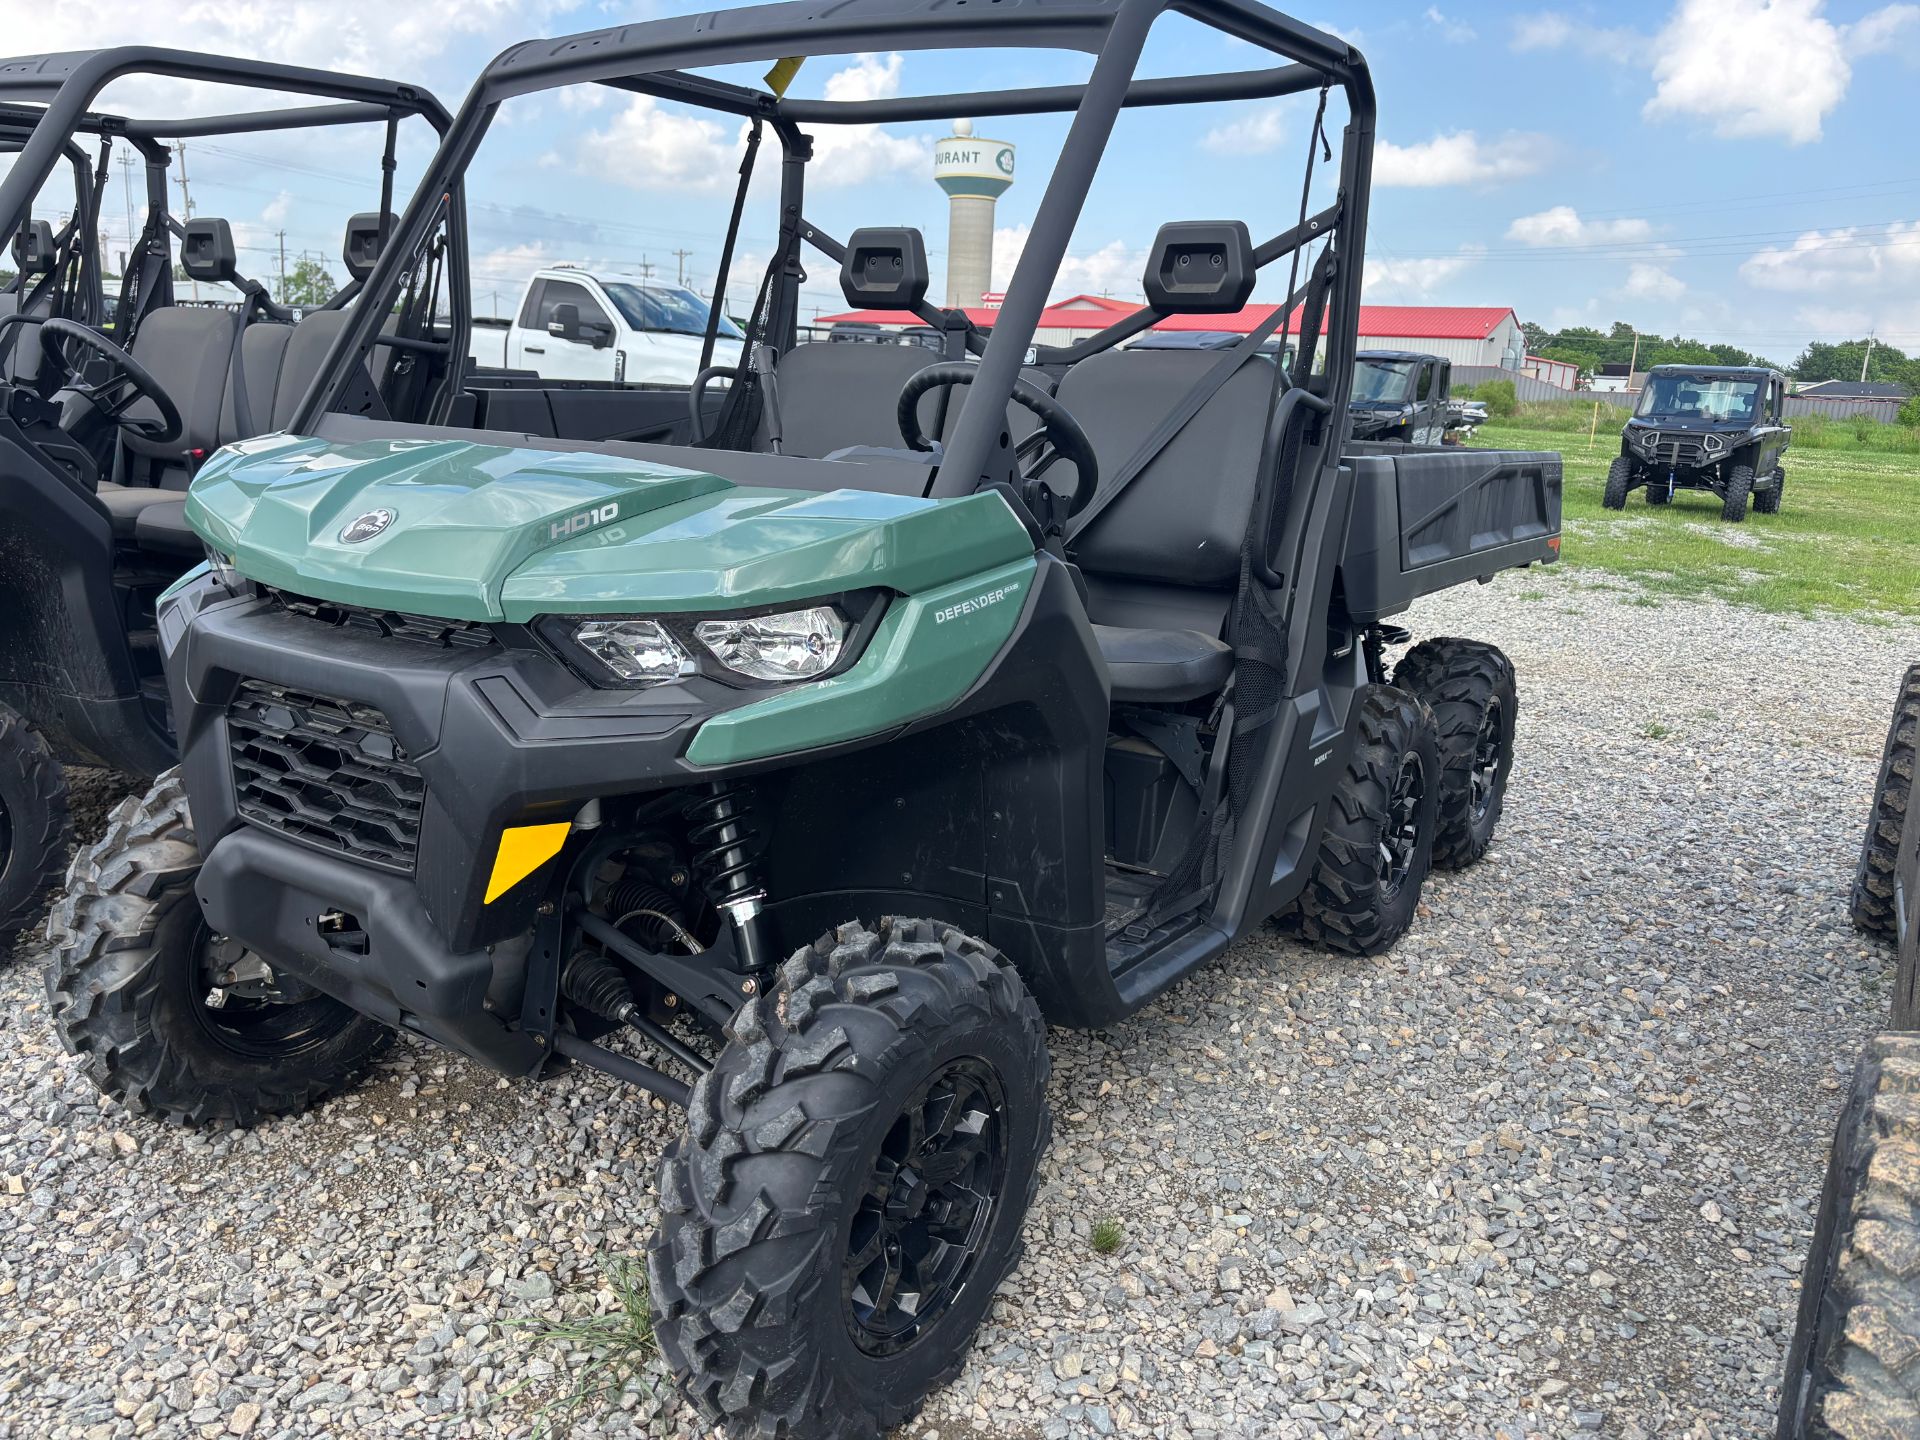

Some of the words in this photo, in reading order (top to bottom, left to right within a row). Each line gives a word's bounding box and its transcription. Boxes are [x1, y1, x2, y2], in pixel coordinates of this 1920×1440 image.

[355, 523, 380, 532] BRP
[551, 502, 619, 540] HD10
[935, 589, 1004, 624] DEFENDER
